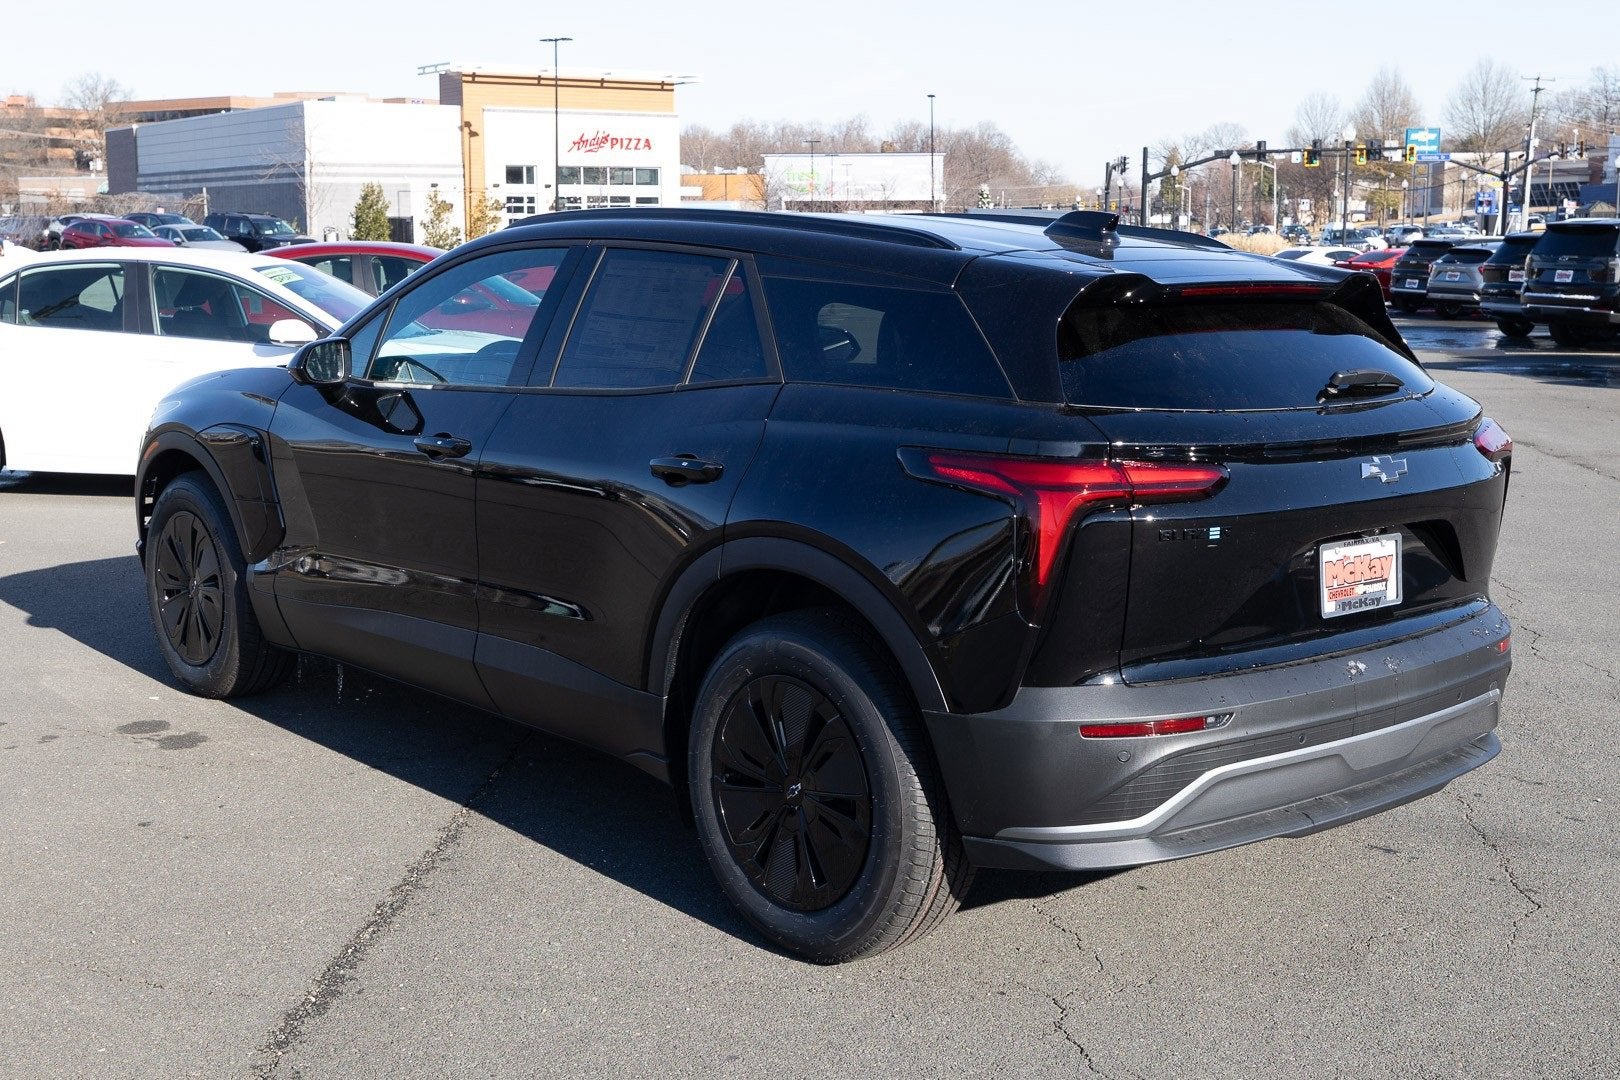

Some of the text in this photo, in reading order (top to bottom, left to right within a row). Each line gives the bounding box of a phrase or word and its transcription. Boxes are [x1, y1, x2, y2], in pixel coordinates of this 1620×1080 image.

[610, 137, 652, 151] PIZZA
[1324, 553, 1394, 589] McKay
[1328, 587, 1355, 600] CHEVROLET
[1341, 596, 1382, 612] McKay
